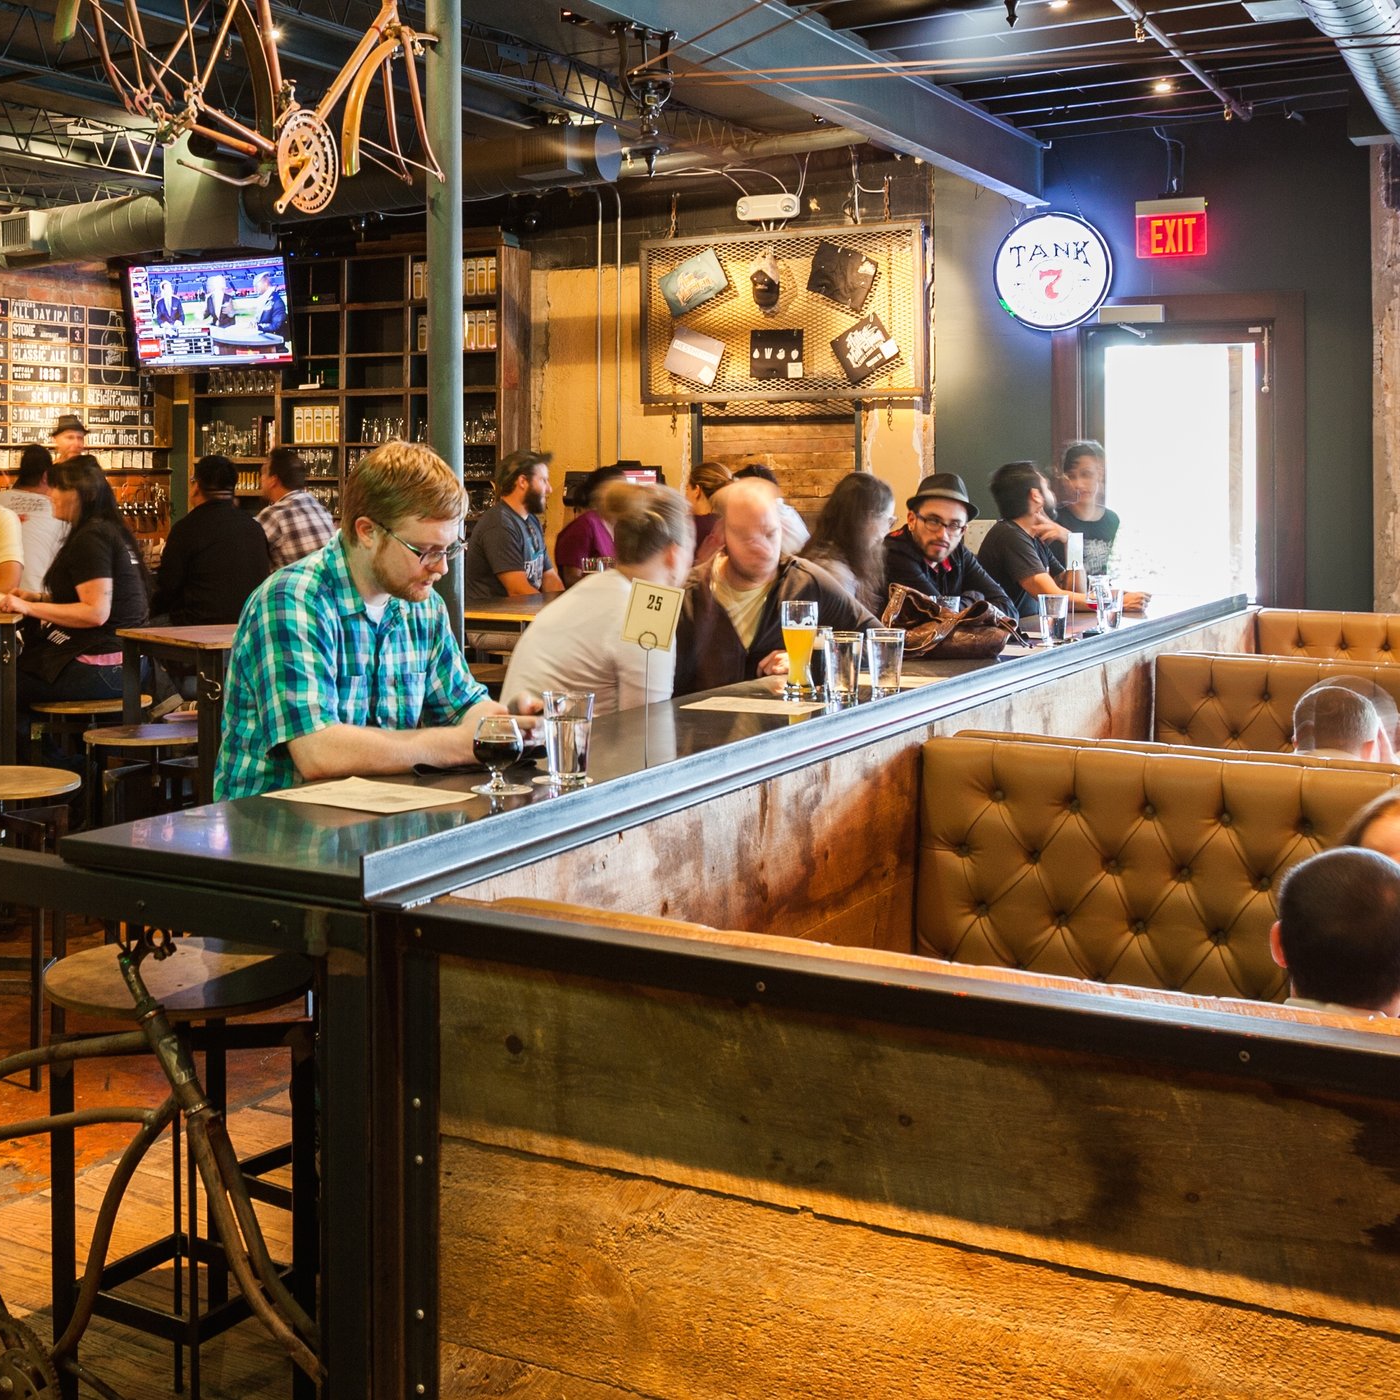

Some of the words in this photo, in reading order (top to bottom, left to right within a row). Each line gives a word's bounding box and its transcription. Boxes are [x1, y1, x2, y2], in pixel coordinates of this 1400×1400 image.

[1150, 217, 1197, 255] EXIT
[1009, 241, 1091, 268] TANK
[1039, 269, 1062, 299] 7
[13, 306, 30, 319] ALL
[33, 308, 51, 321] DAY
[54, 309, 68, 322] IPA
[12, 323, 36, 338] STONE
[118, 434, 137, 446] ROSE
[646, 594, 664, 612] 25
